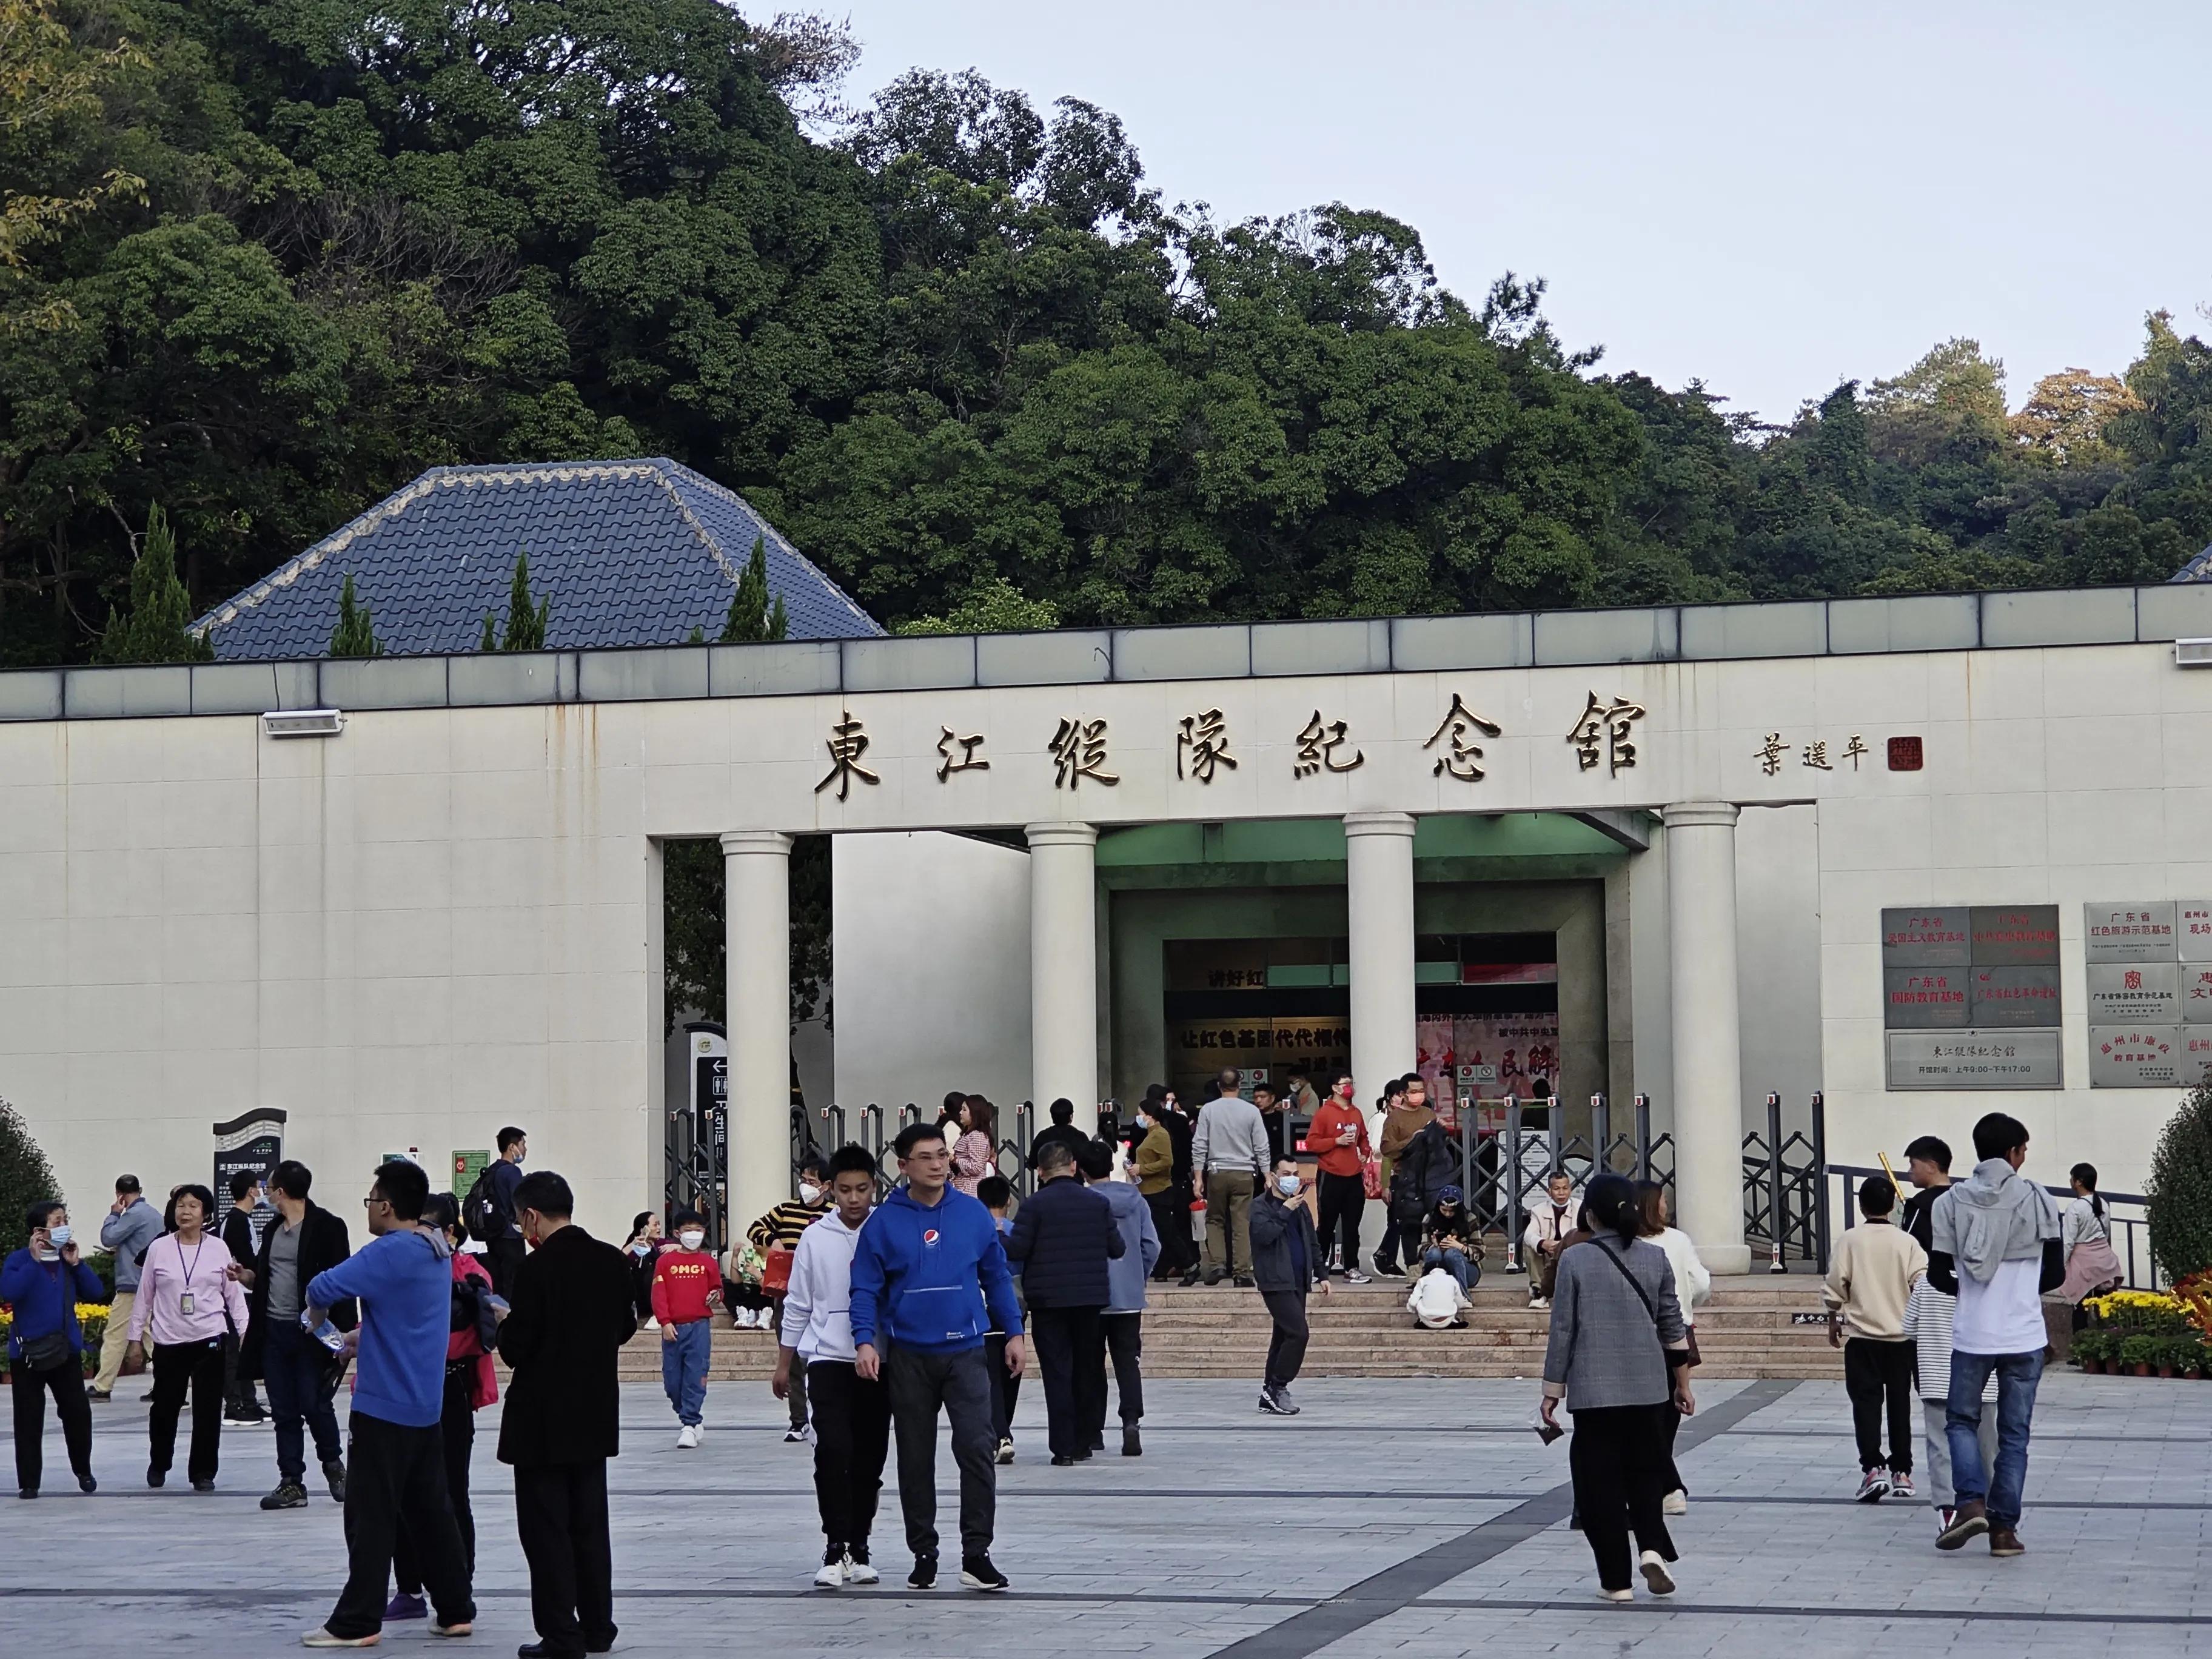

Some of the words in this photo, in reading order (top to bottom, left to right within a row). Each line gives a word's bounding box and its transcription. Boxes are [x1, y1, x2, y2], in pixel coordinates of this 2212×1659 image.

[1909, 917, 1943, 928] 广东省
[2111, 912, 2150, 922] 广东省
[2090, 924, 2171, 936] 红色旅游示范基地
[1908, 976, 1948, 988] 广东省
[1891, 990, 1964, 1004] 国防教育基地
[2190, 988, 2212, 999] 文
[670, 1264, 705, 1275] OMG!
